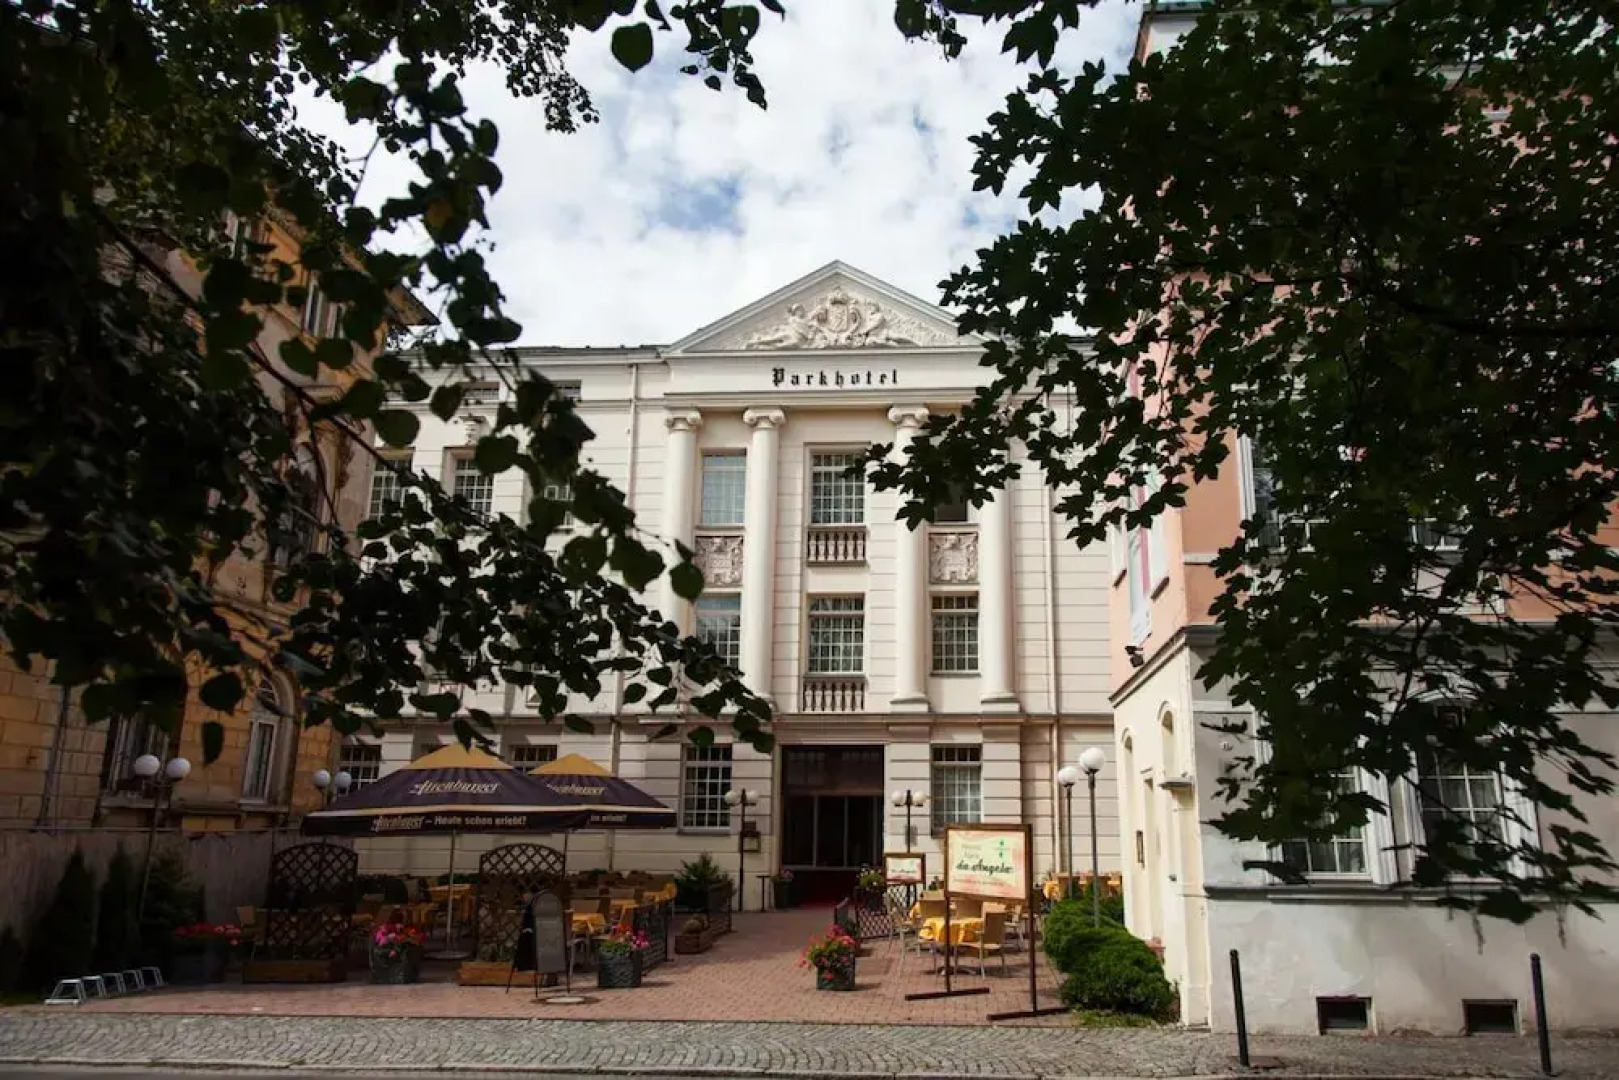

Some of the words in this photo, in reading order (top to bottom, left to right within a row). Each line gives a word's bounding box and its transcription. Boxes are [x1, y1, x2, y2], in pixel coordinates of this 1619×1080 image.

[772, 367, 898, 388] Parkhotel
[434, 815, 462, 825] Heute
[465, 815, 493, 825] schon
